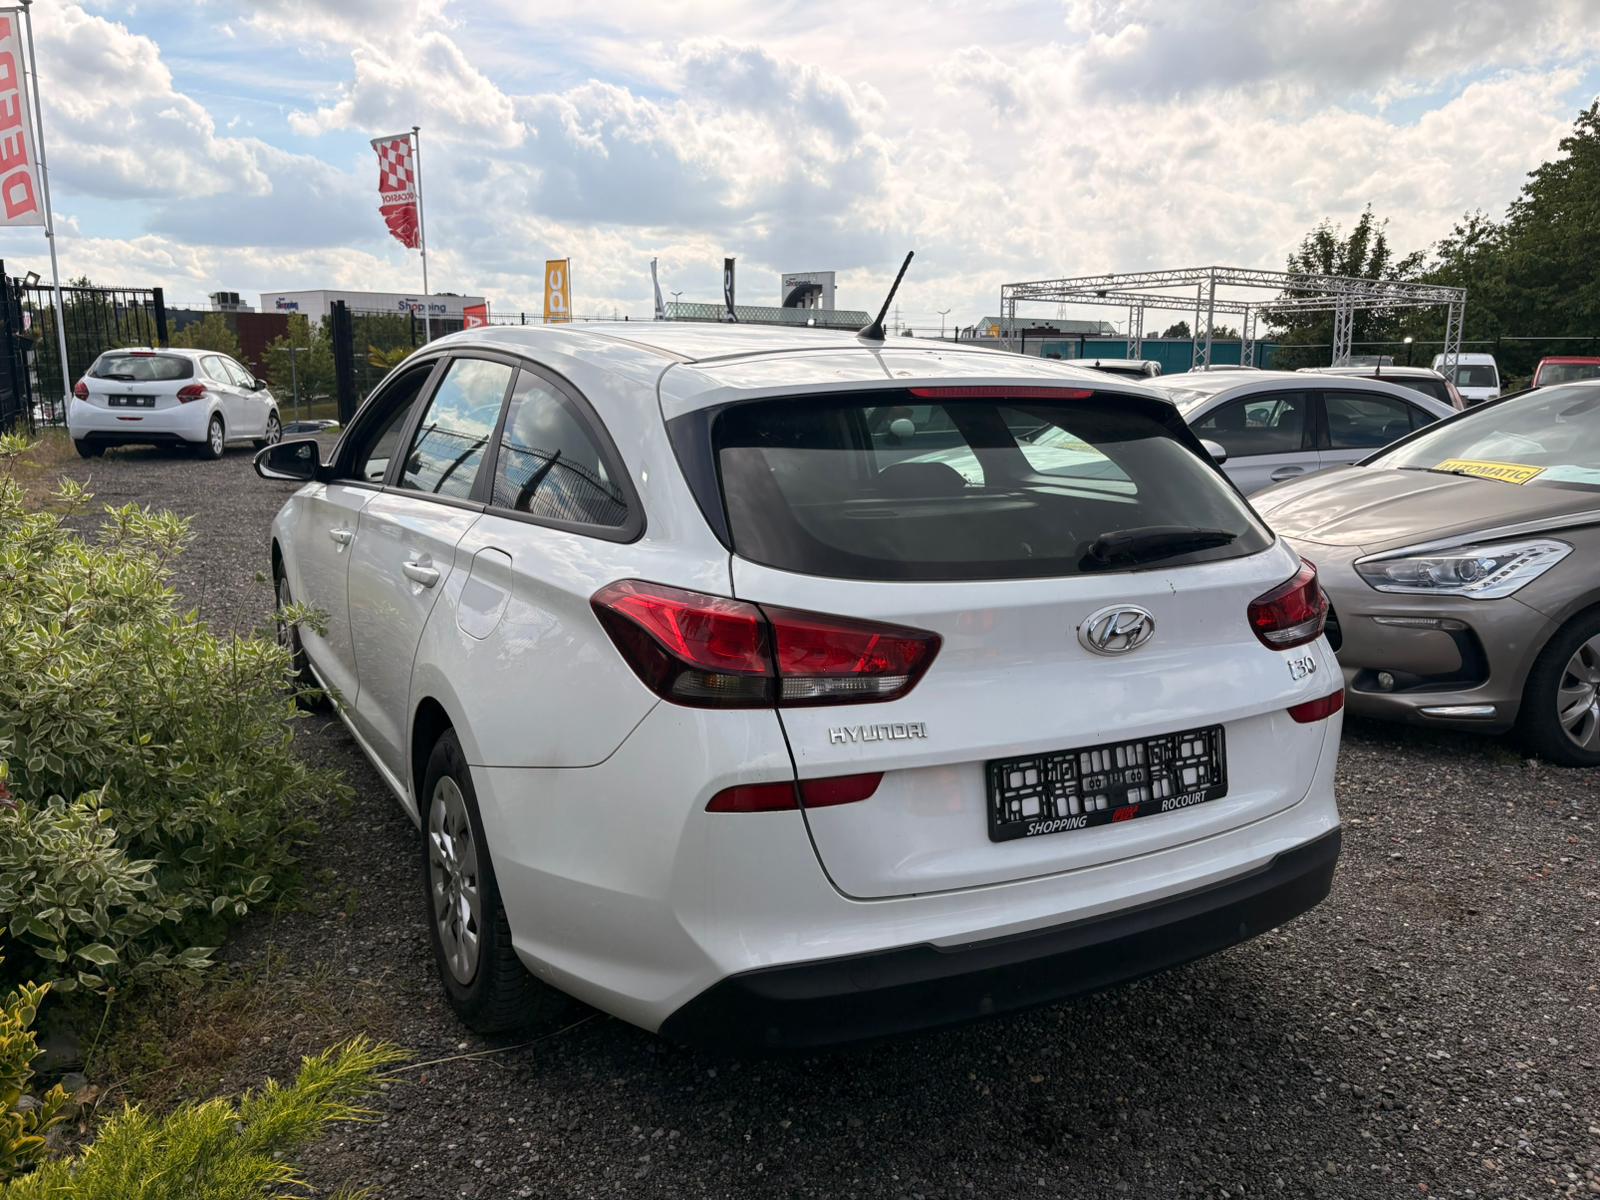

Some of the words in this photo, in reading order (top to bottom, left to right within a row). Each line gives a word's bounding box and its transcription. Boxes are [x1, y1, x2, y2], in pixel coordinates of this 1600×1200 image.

[1440, 463, 1531, 480] AUTOMATIC
[828, 722, 928, 745] HYUNDAI
[1026, 815, 1088, 837] SHOPPING
[1161, 790, 1208, 812] ROCOURT
